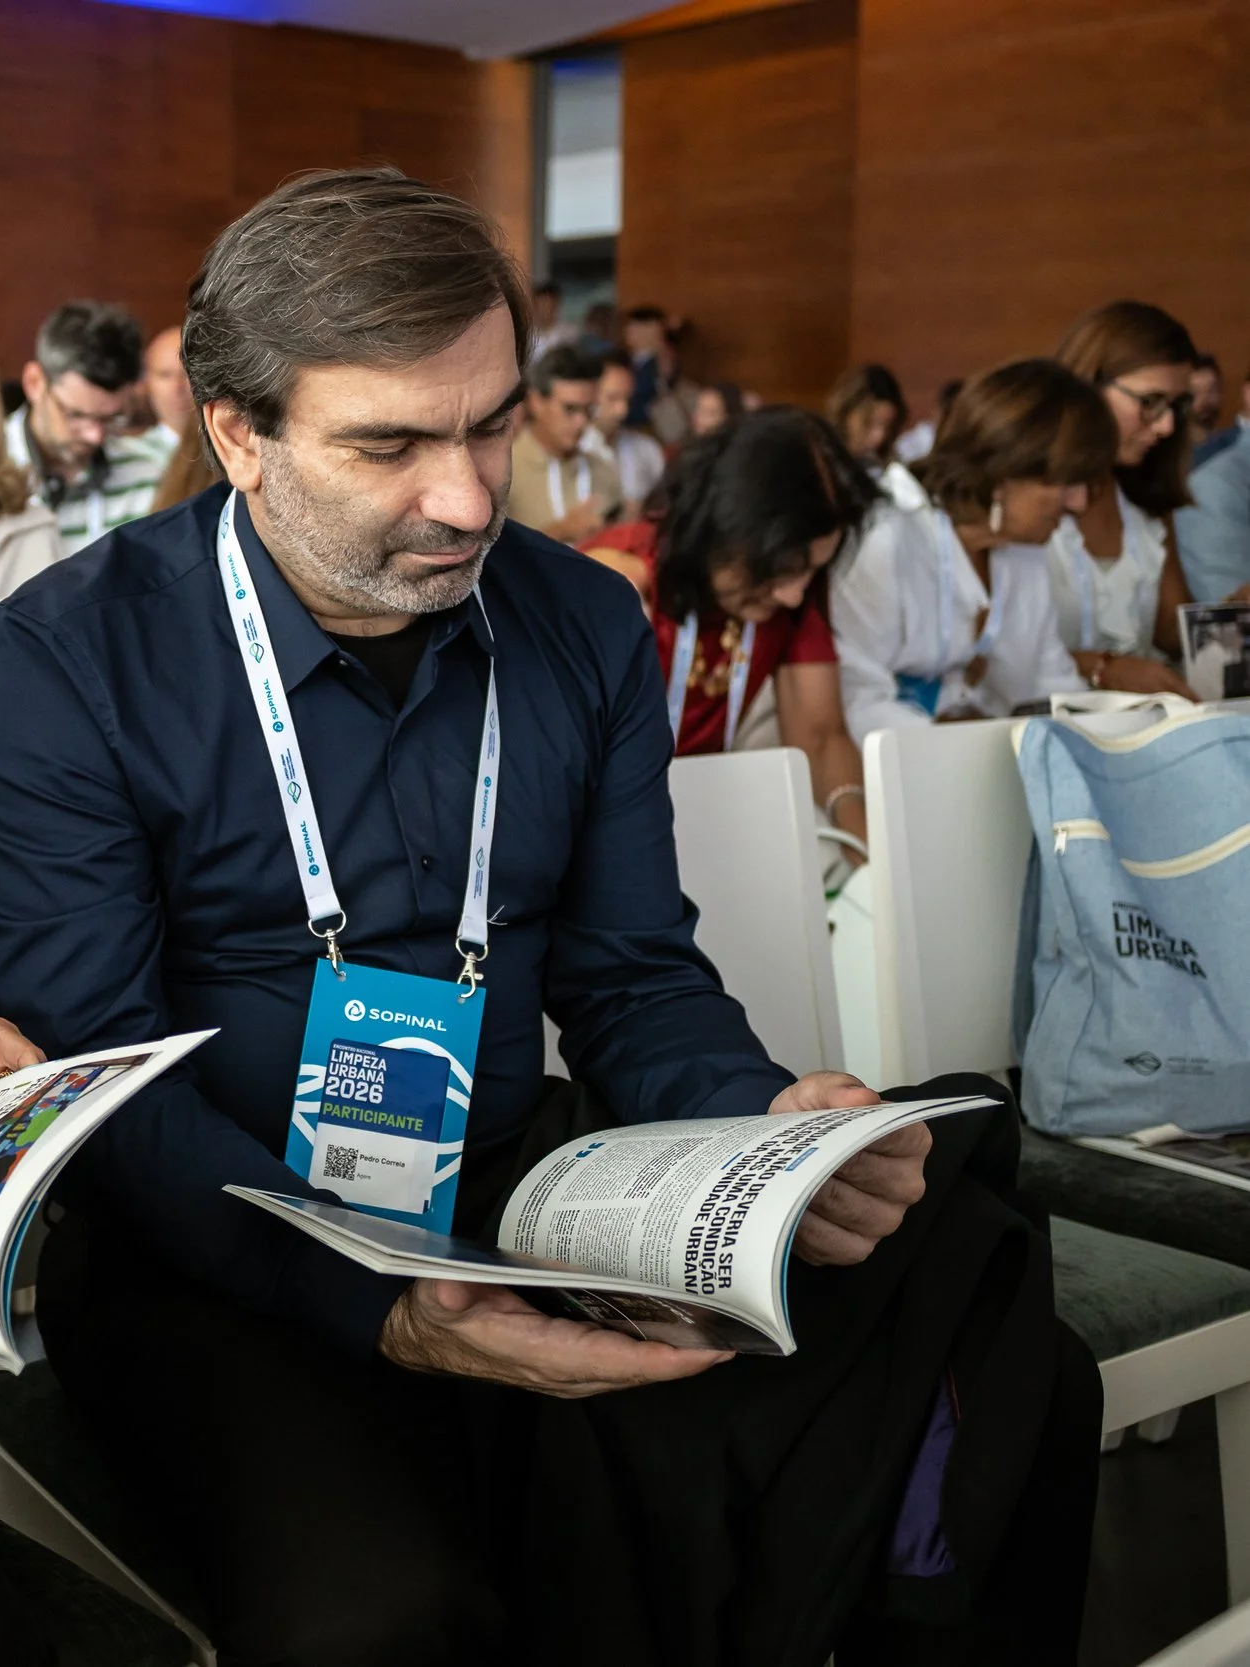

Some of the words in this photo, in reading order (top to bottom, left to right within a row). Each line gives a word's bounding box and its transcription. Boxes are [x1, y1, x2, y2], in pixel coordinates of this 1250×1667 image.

[228, 552, 242, 589] SOPINAL
[262, 678, 279, 720] SOPINAL
[300, 820, 316, 864] SOPINAL
[1113, 911, 1199, 958] LIMPZA
[368, 1007, 448, 1032] SOPINAL
[328, 1062, 385, 1085] URBANA
[330, 1049, 387, 1072] LIMPEZA
[325, 1077, 384, 1105] 2026
[323, 1102, 424, 1132] PARTICIPANTE
[359, 1153, 380, 1165] Pedro
[748, 1148, 785, 1173] MAS
[758, 1157, 792, 1182] NÃO
[693, 1154, 756, 1226] DIGNIDADE
[720, 1173, 756, 1203] UMA
[719, 1182, 766, 1246] DEVERIA
[697, 1205, 730, 1297] CONDIÇÃO
[717, 1252, 732, 1289] SER
